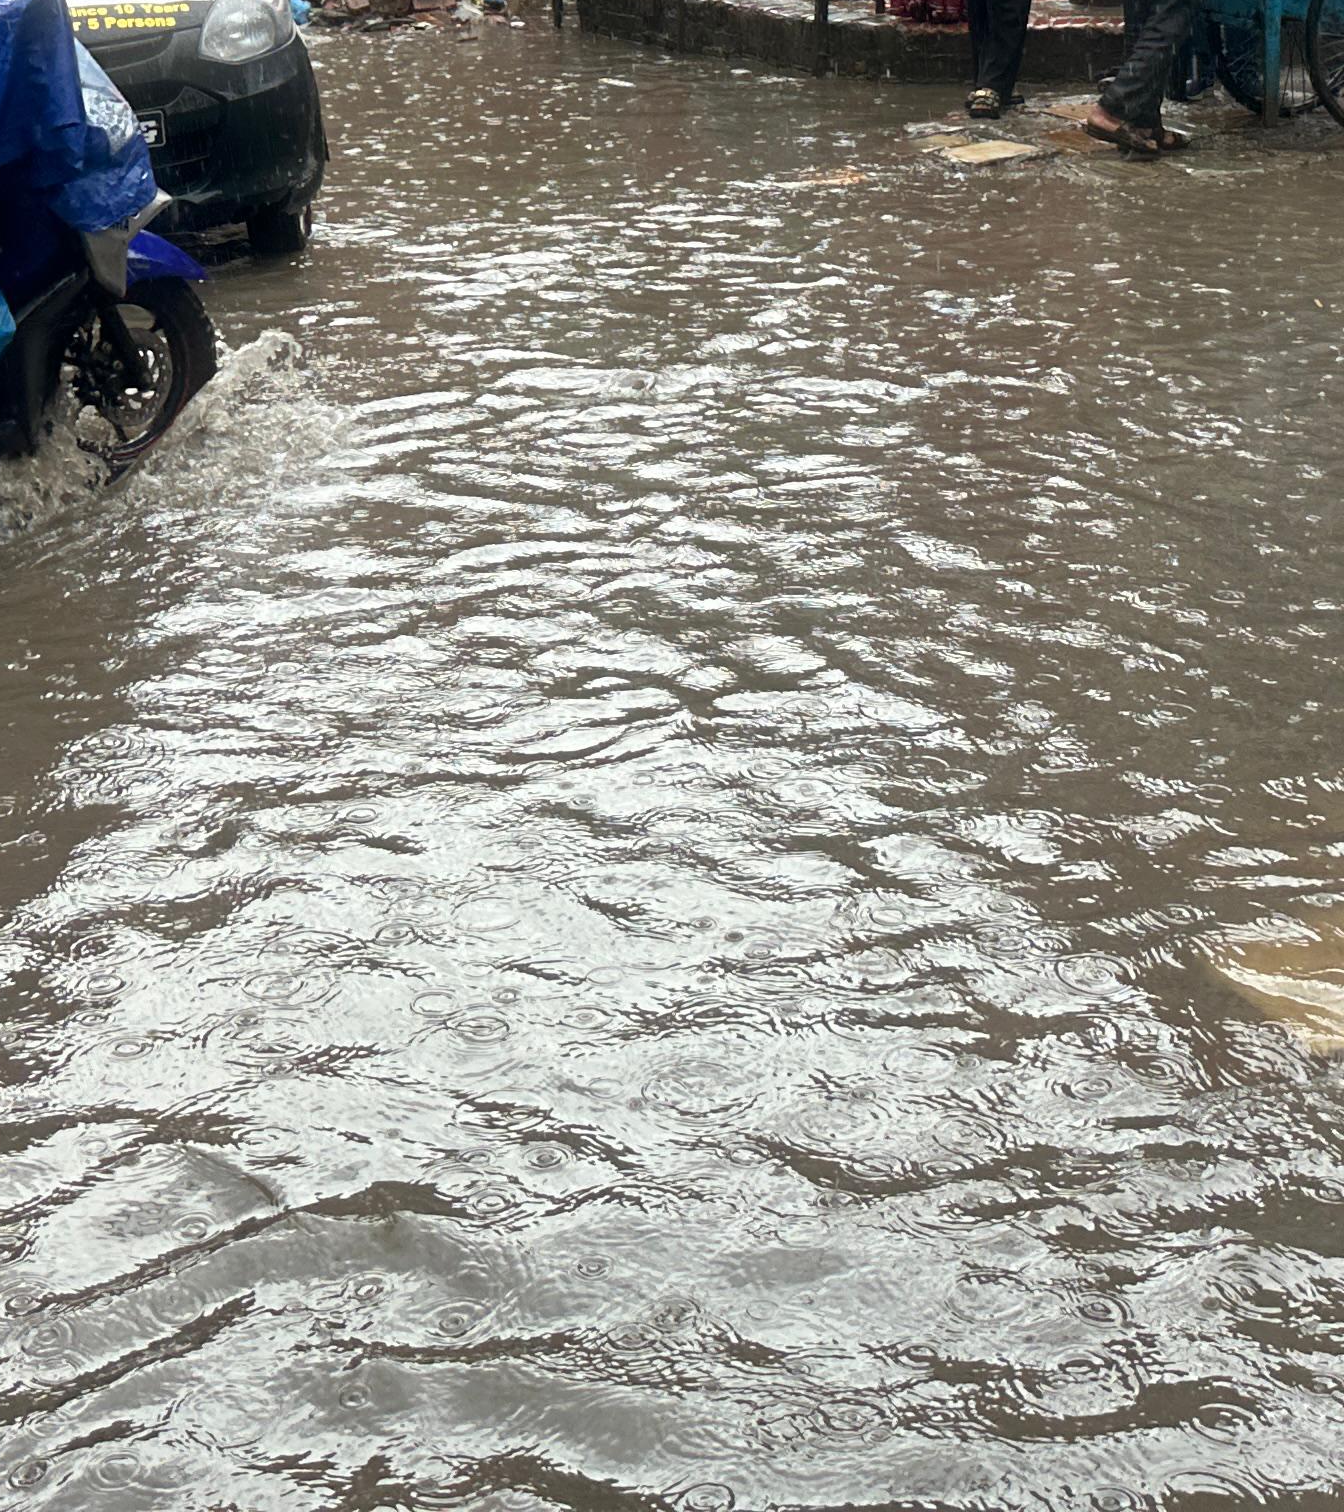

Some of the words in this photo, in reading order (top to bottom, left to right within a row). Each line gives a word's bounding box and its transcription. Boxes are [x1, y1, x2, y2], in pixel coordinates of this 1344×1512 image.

[70, 7, 108, 18] ince
[114, 4, 135, 15] 10
[140, 3, 190, 14] Years
[87, 17, 100, 30] 5
[104, 16, 176, 29] Persons
